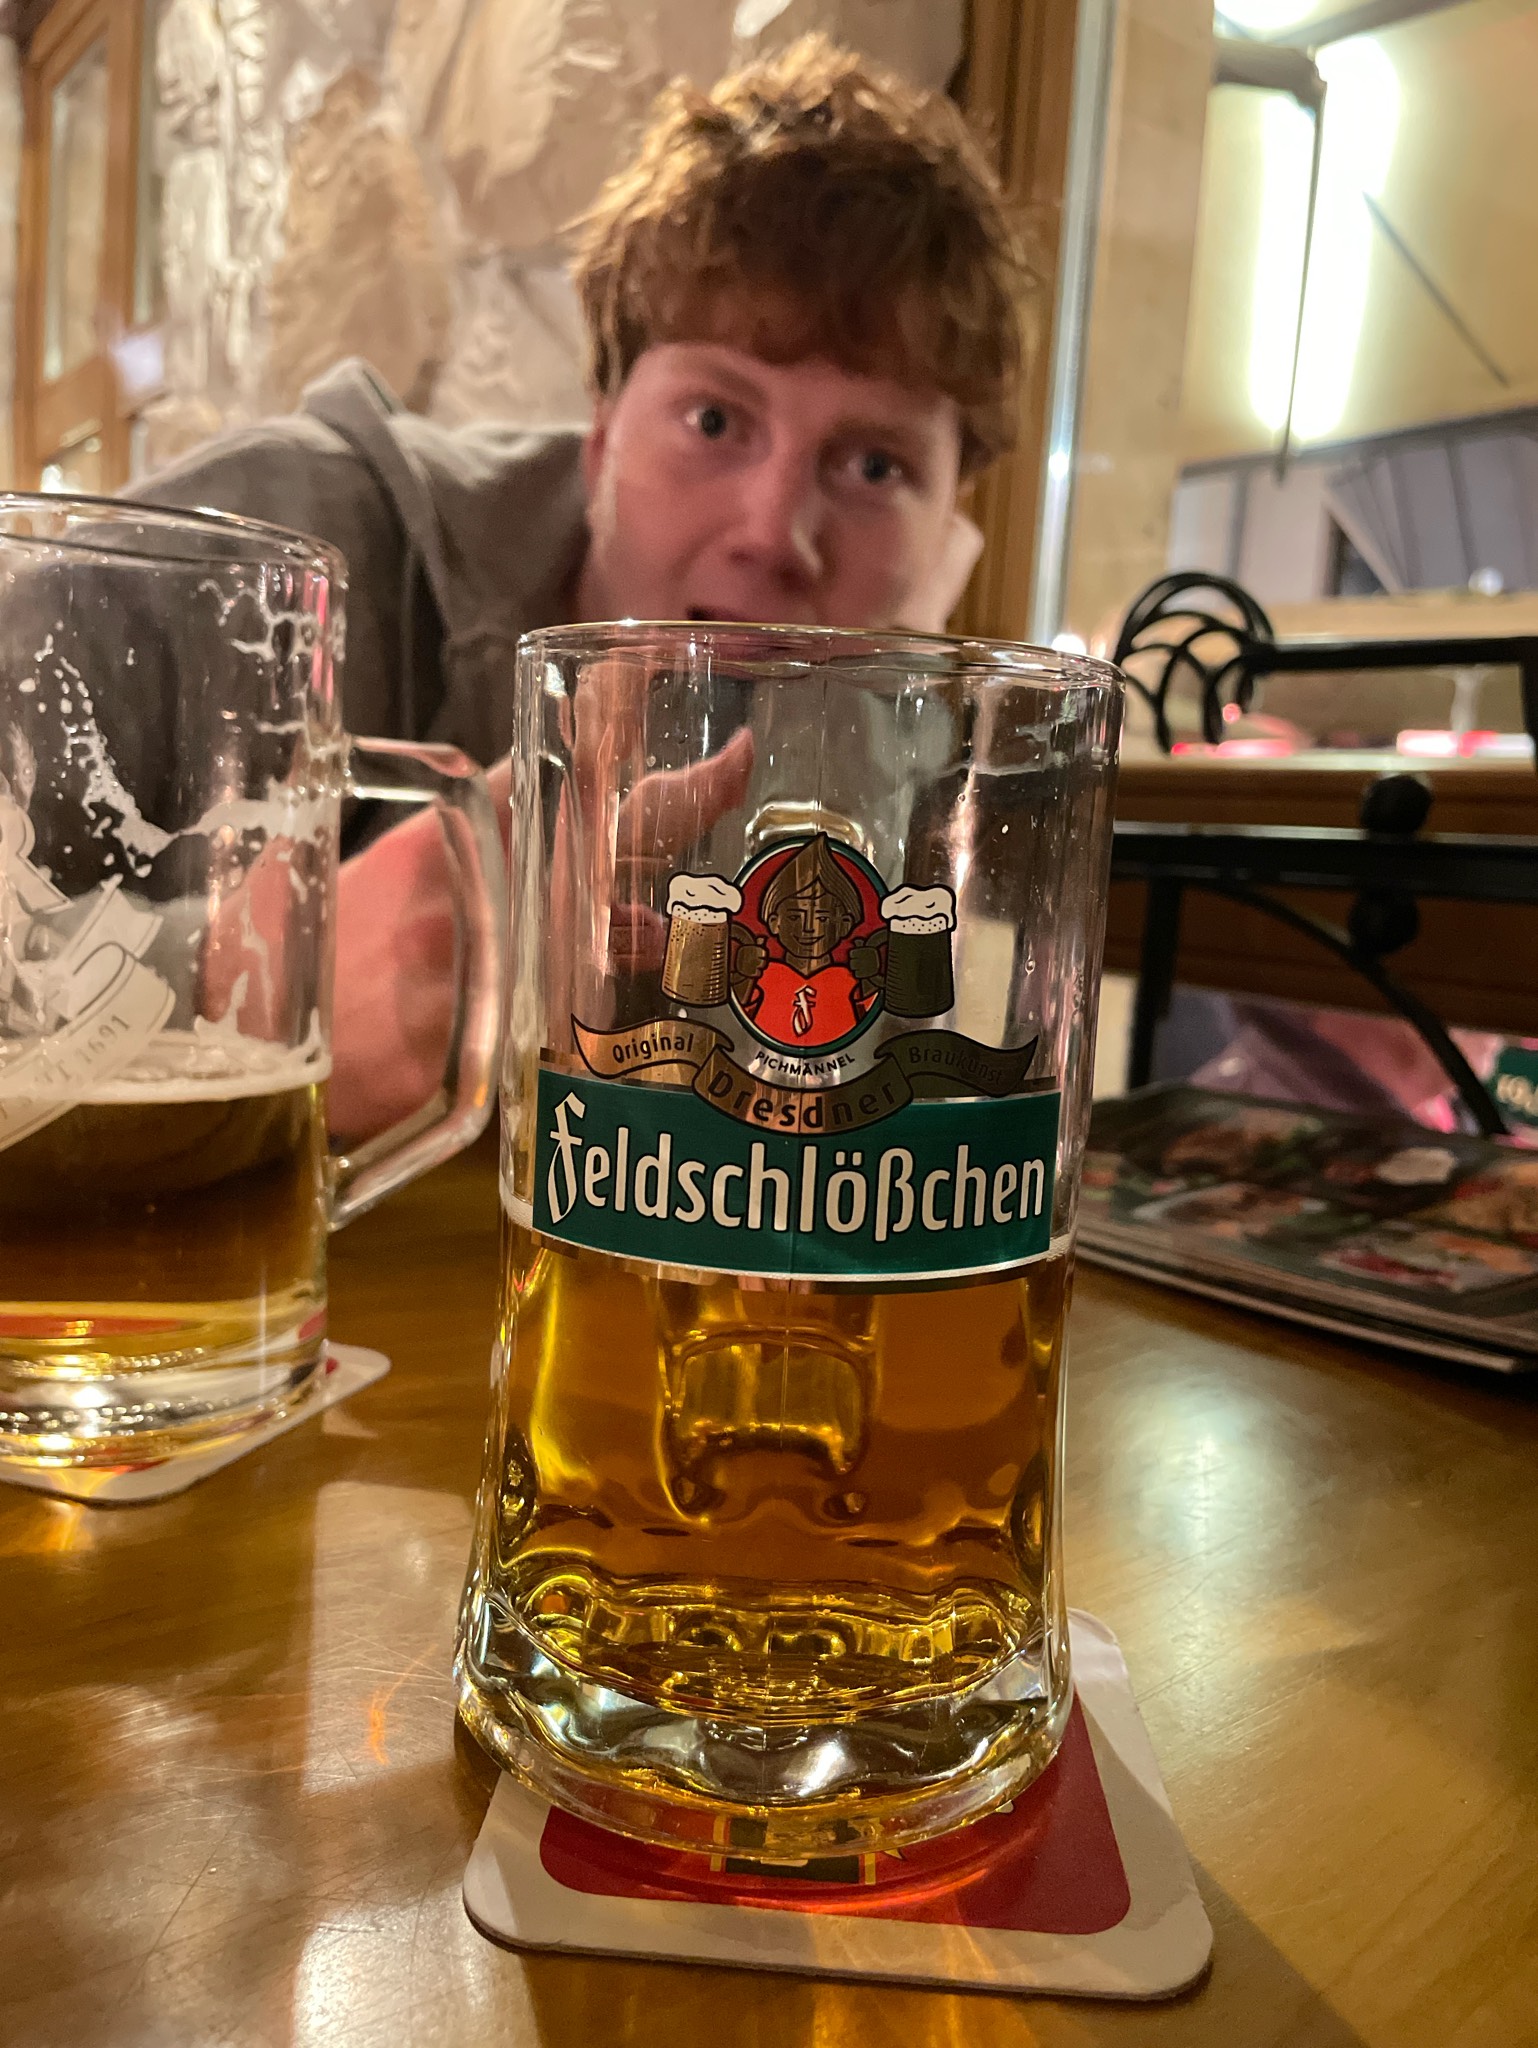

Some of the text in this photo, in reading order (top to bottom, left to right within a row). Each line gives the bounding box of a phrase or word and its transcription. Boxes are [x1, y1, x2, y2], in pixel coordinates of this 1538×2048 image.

[612, 1033, 1002, 1129] Original Dresdner Braukunst
[755, 1050, 856, 1077] PICHMÄNNEL
[546, 1091, 1045, 1243] Feldschlößchen
